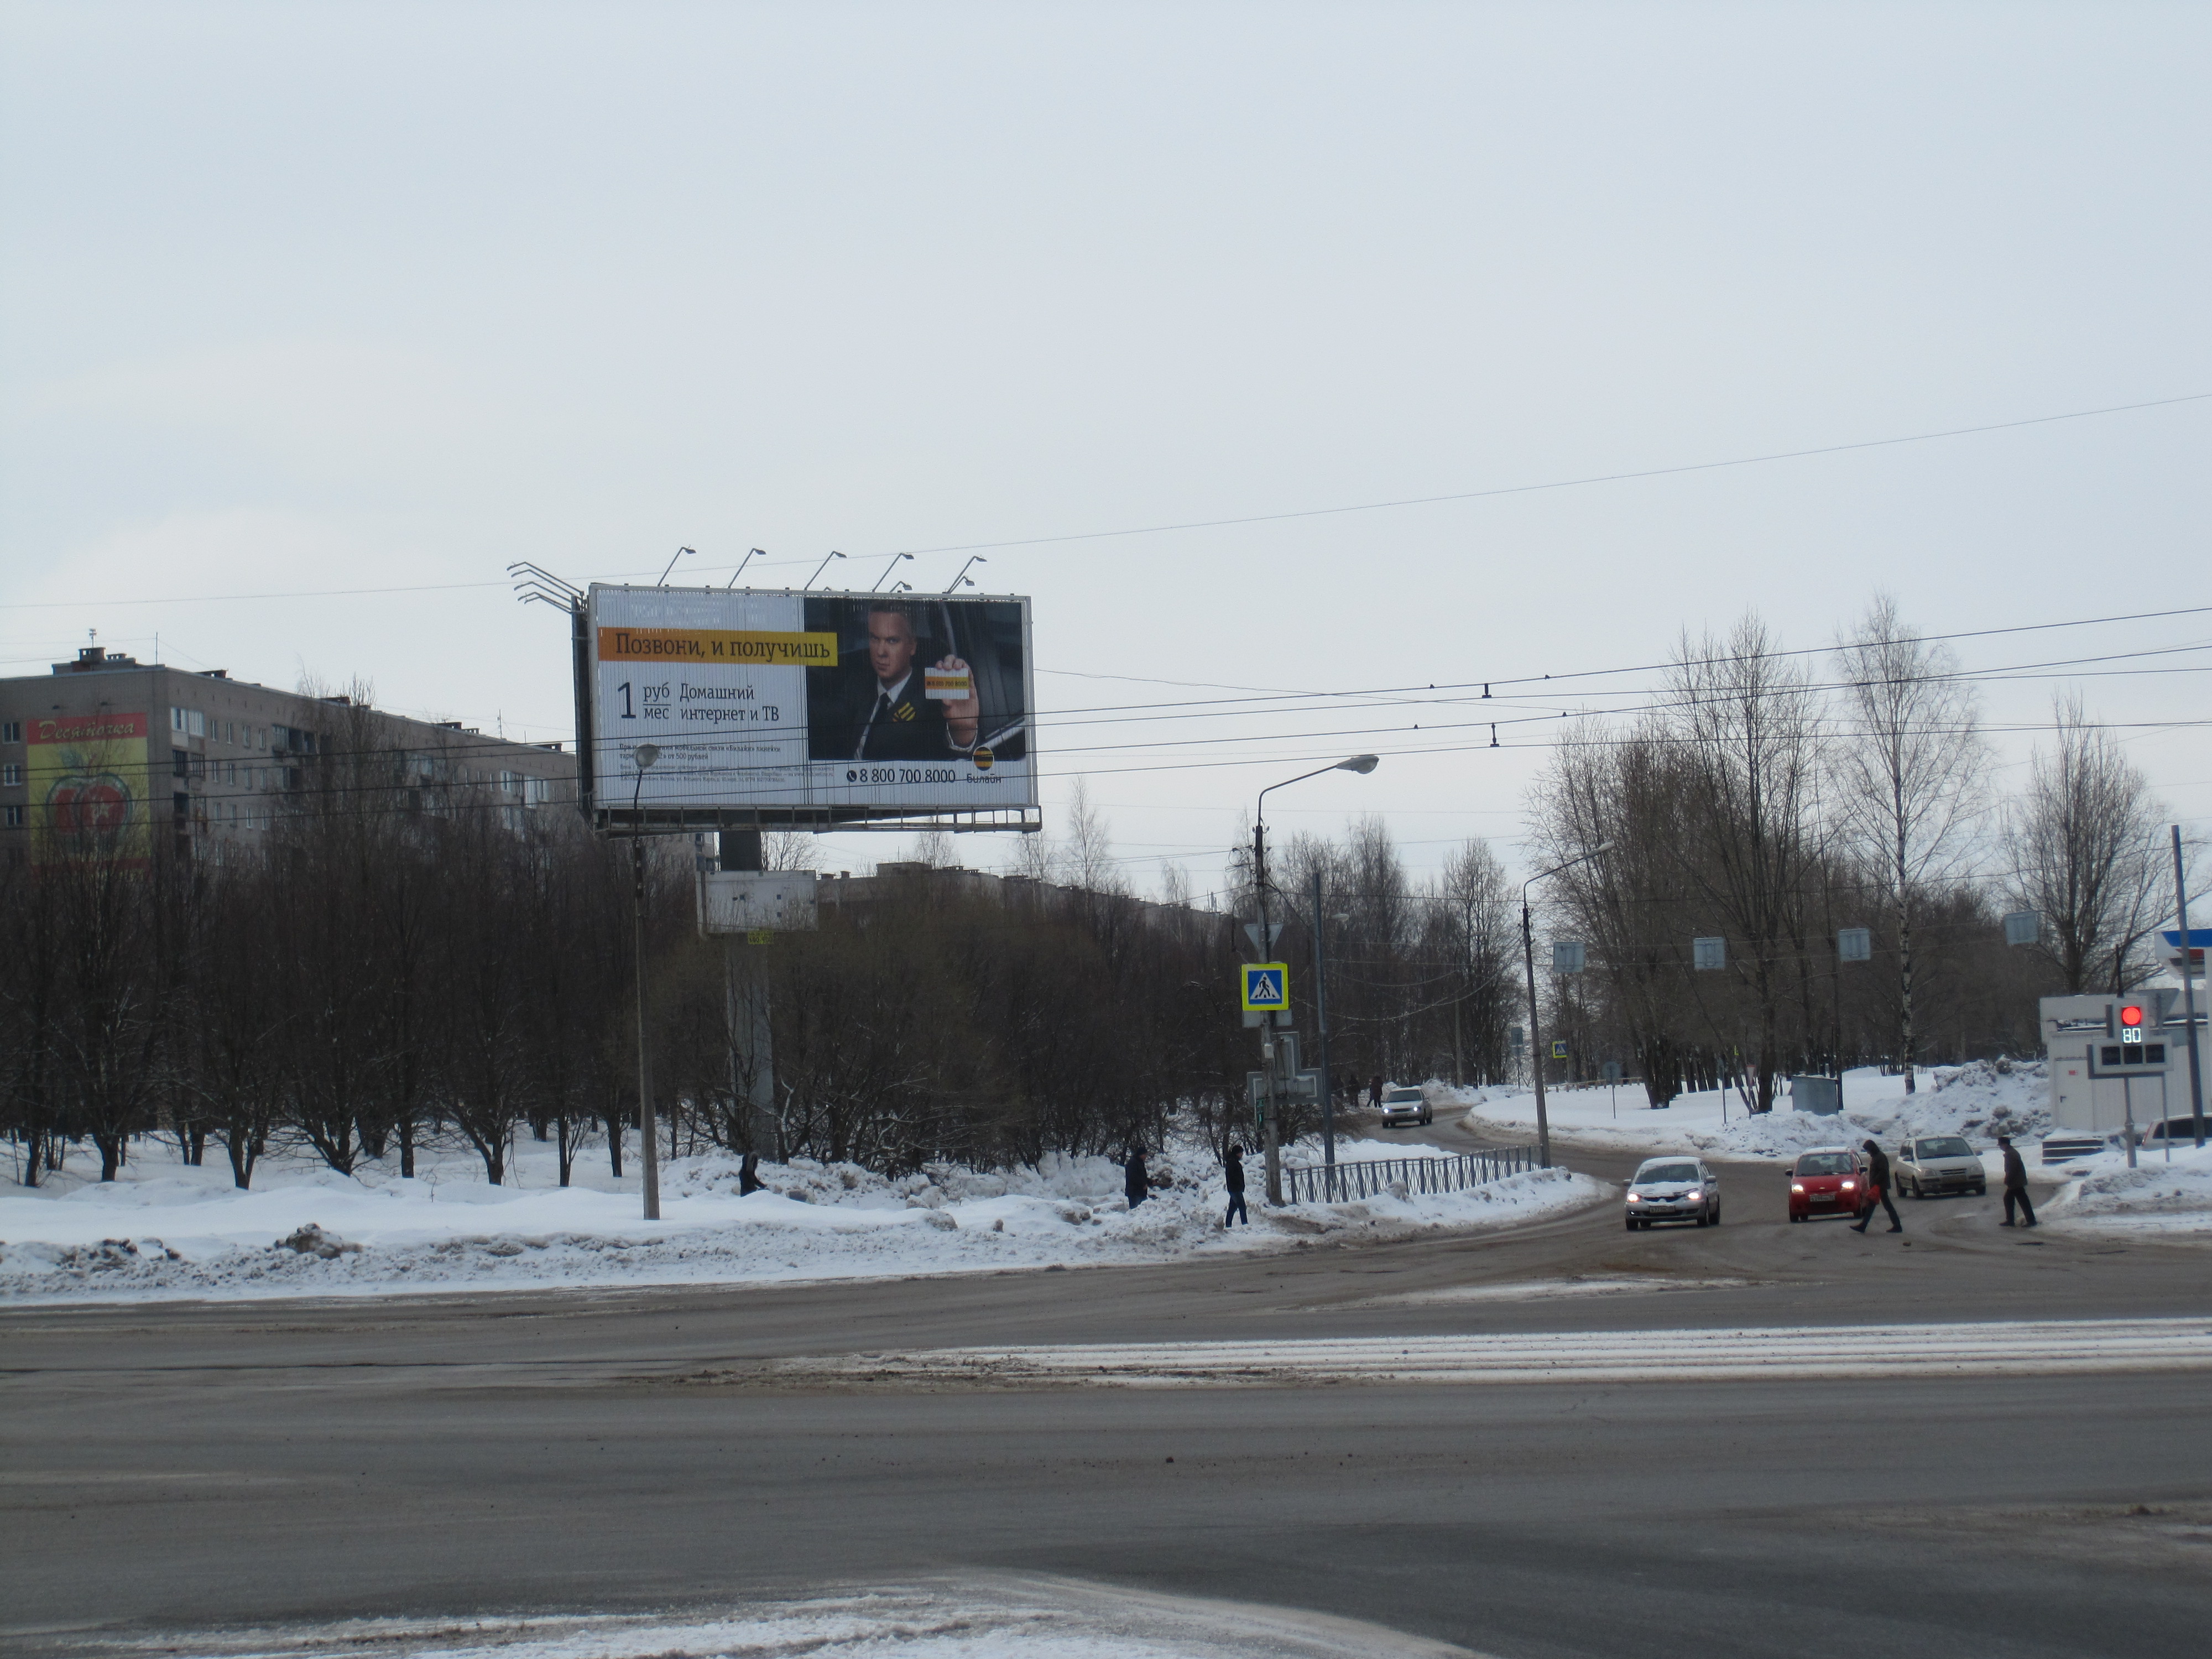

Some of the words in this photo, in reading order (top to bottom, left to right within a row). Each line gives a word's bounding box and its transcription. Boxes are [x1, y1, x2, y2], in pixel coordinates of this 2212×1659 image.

[615, 633, 706, 658] Позвони,
[711, 641, 724, 655] и
[730, 641, 830, 662] получишь
[618, 682, 636, 718] 1
[643, 682, 670, 702] руб
[680, 683, 754, 702] Домашний
[644, 708, 669, 719] мес
[681, 708, 745, 724] интернет
[750, 710, 758, 721] и
[763, 706, 779, 721] ТВ
[39, 720, 135, 739] Десяточка
[687, 753, 708, 761] рублей
[859, 768, 868, 782] 8
[872, 768, 895, 783] 800
[899, 769, 921, 784] 700
[925, 769, 956, 783] 8000
[2122, 1027, 2142, 1044] 80
